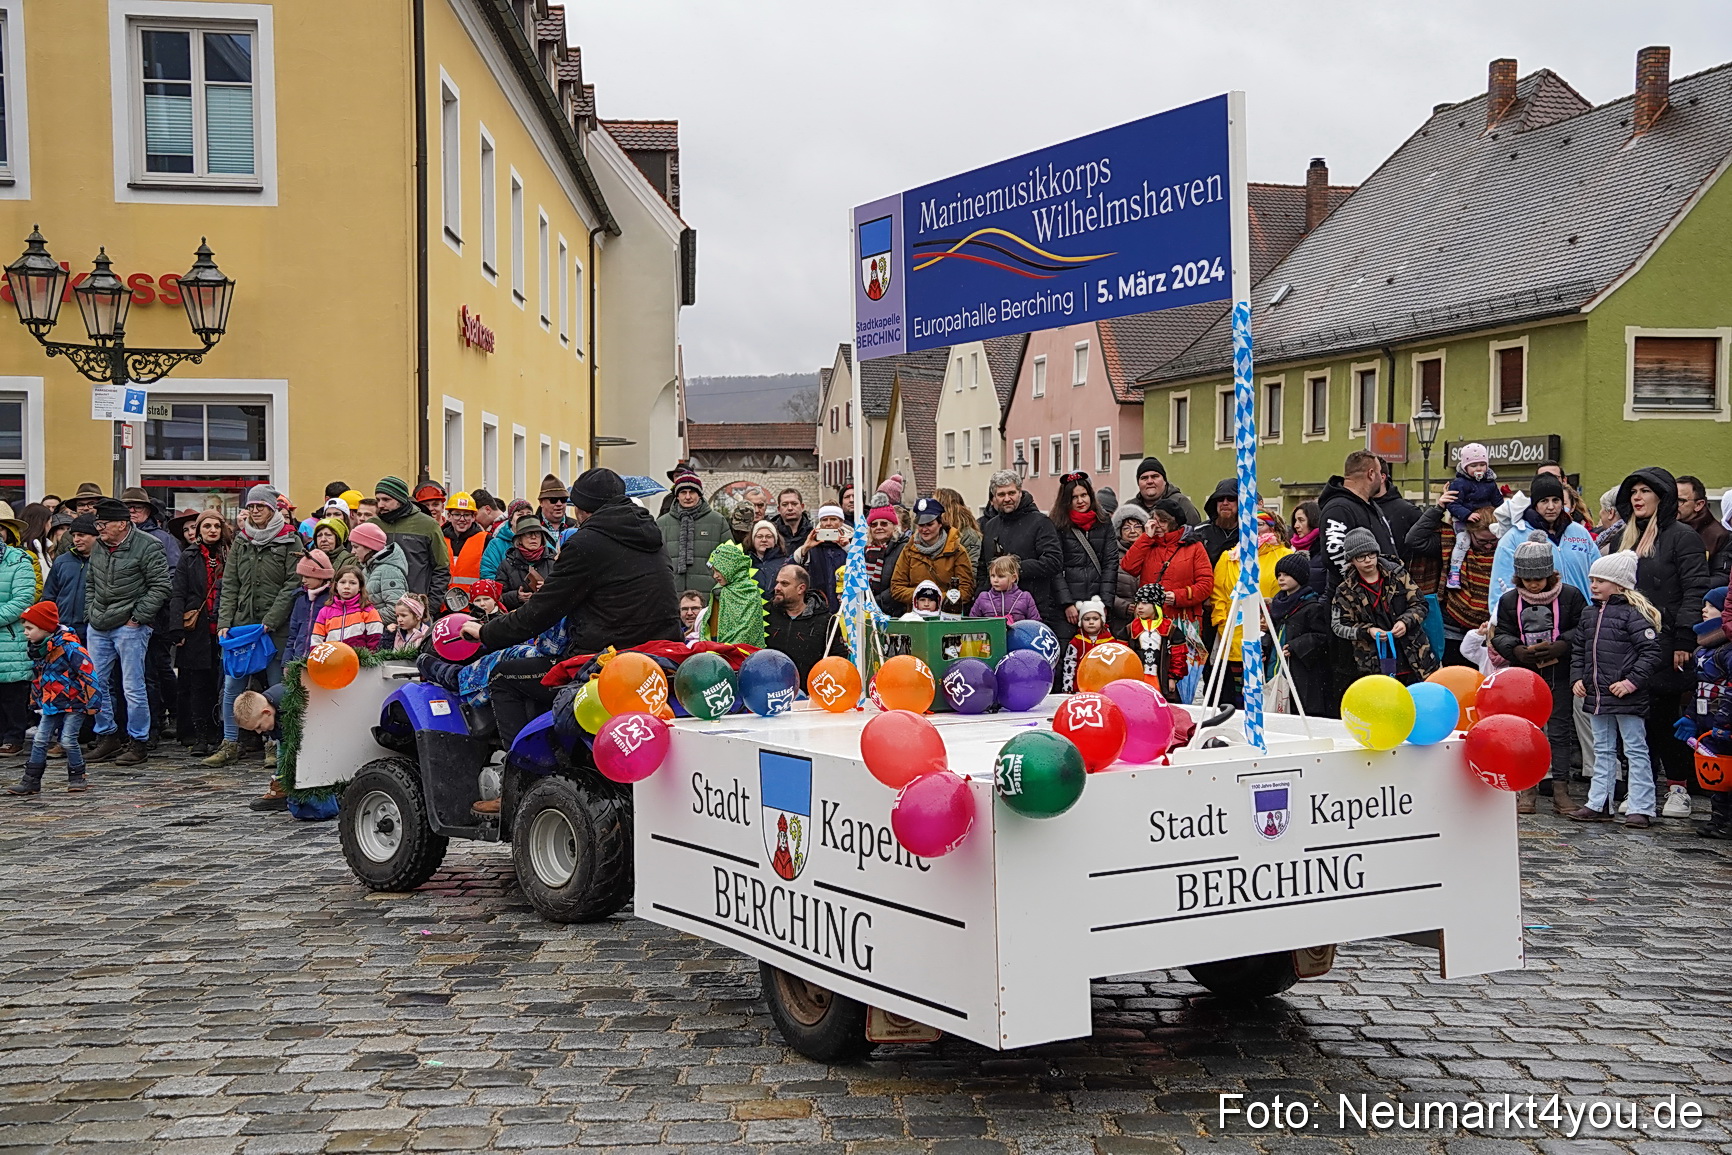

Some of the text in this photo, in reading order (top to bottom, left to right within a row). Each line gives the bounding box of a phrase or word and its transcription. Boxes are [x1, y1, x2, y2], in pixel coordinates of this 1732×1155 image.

[918, 157, 1112, 234] Marinemusikkorps
[1031, 173, 1224, 244] Wilhelmshaven
[914, 255, 1226, 339] Europahalle Berching 5. März 2024
[856, 312, 901, 333] Stadtkapelle
[856, 327, 901, 350] BERCHING
[1508, 439, 1545, 462] Dess
[635, 669, 658, 696] Müller
[702, 678, 728, 697] Müller
[811, 669, 828, 687] Müller
[942, 668, 960, 686] Müller
[767, 685, 794, 699] Müller
[1074, 704, 1094, 719] M
[609, 730, 632, 757] Müller
[1013, 754, 1025, 795] Müller
[691, 771, 932, 872] Stadt Kape
[1149, 804, 1228, 843] Stadt
[1309, 785, 1413, 830] Kapelle
[1176, 853, 1365, 912] BERCHING
[713, 865, 874, 973] BERCHING
